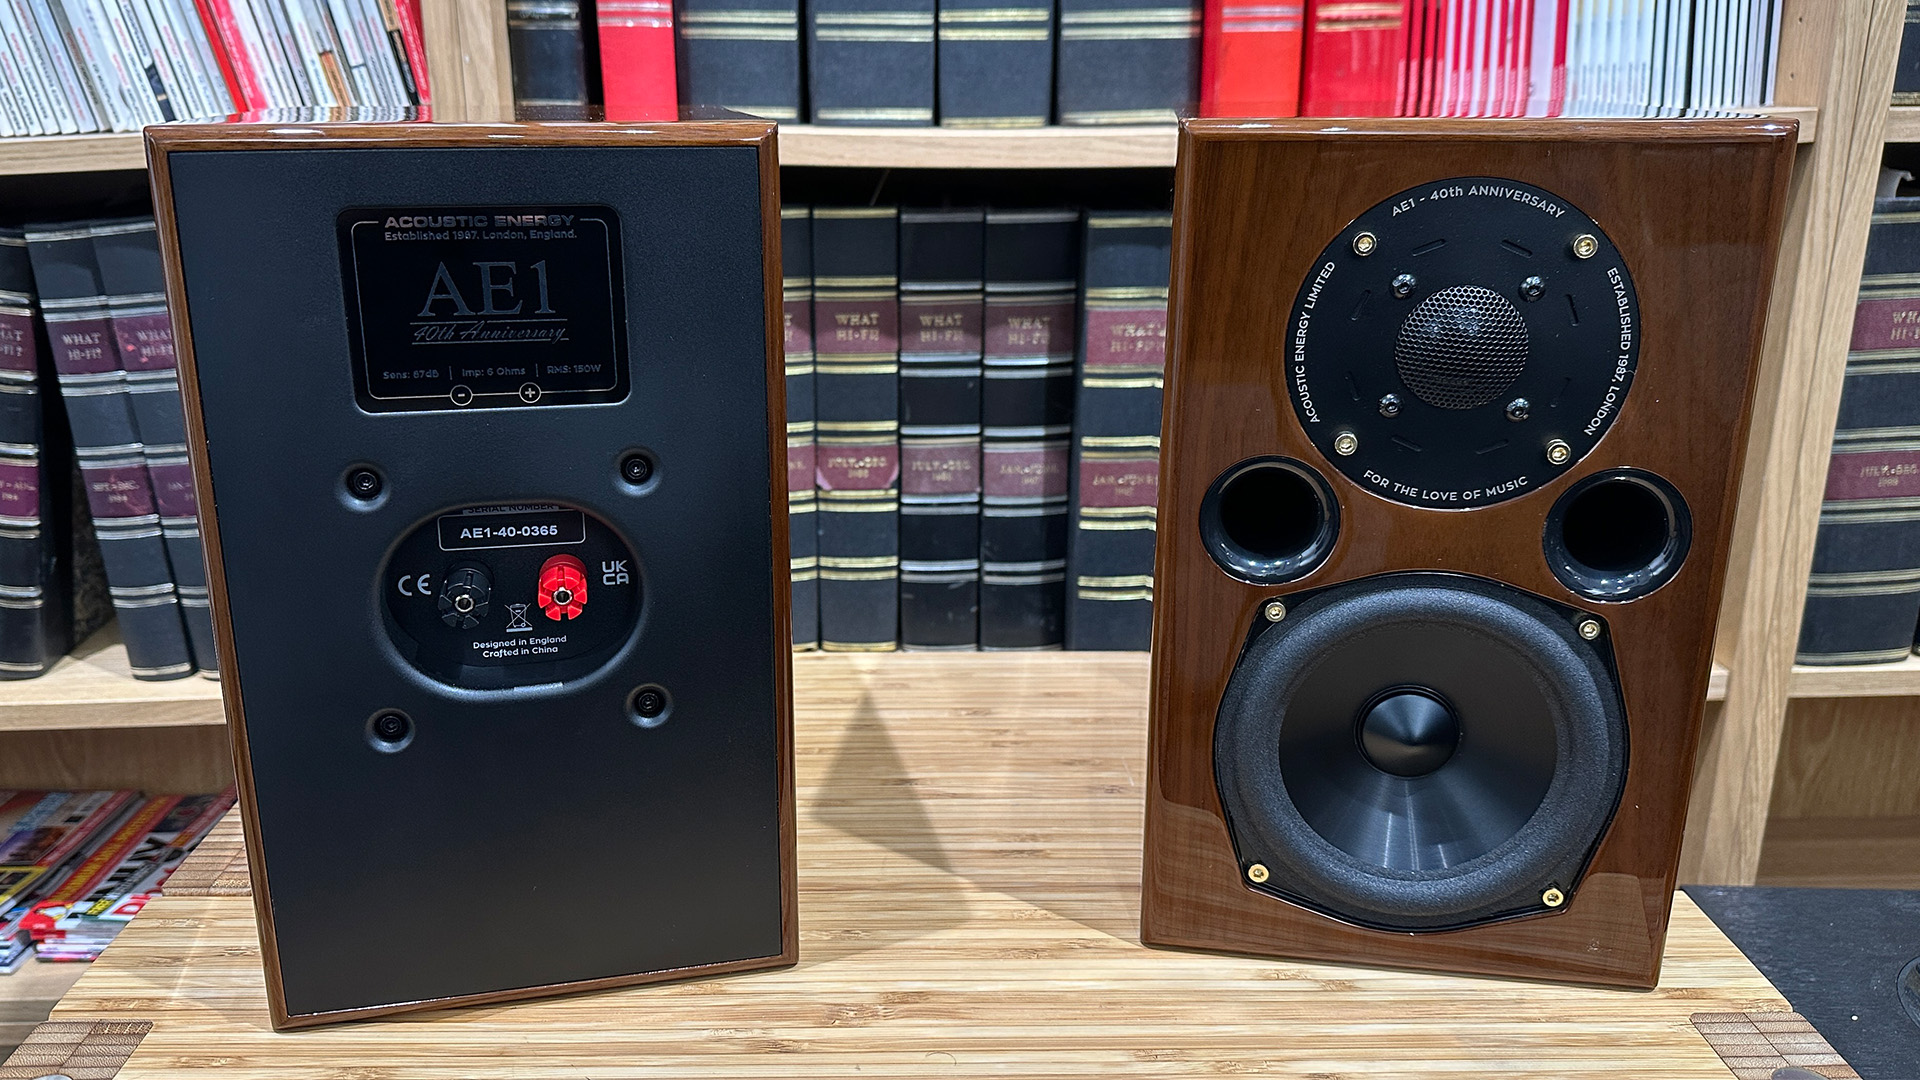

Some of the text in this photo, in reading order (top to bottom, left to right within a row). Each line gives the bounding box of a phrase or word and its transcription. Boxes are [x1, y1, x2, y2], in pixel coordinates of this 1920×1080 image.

[1392, 198, 1416, 217] AE1
[1430, 186, 1463, 201] 40th
[1468, 185, 1566, 219] ANNIVERSARY
[384, 214, 575, 229] ACOUSTIC ENERGY
[384, 230, 451, 241] Established
[482, 230, 528, 241] London,
[529, 228, 578, 241] England.
[416, 258, 557, 317] AE1
[834, 312, 880, 326] WHAT
[919, 313, 963, 326] WHAT
[413, 320, 566, 345] 40th Anniversary
[1295, 261, 1336, 423] ACOUSTIC ENERGY LIMITED
[1583, 267, 1632, 436] ESTABLISHED 1987, LONDON
[382, 370, 411, 380] Sens:
[461, 366, 526, 379] Imp: 6 Ohms
[546, 363, 602, 375] RMS: 150W
[1363, 469, 1529, 501] FOR THE LOVE OF MUSIC
[460, 525, 559, 539] AE1-40-0365
[472, 635, 567, 650] Designed in England
[482, 645, 559, 659] Crafted in China
